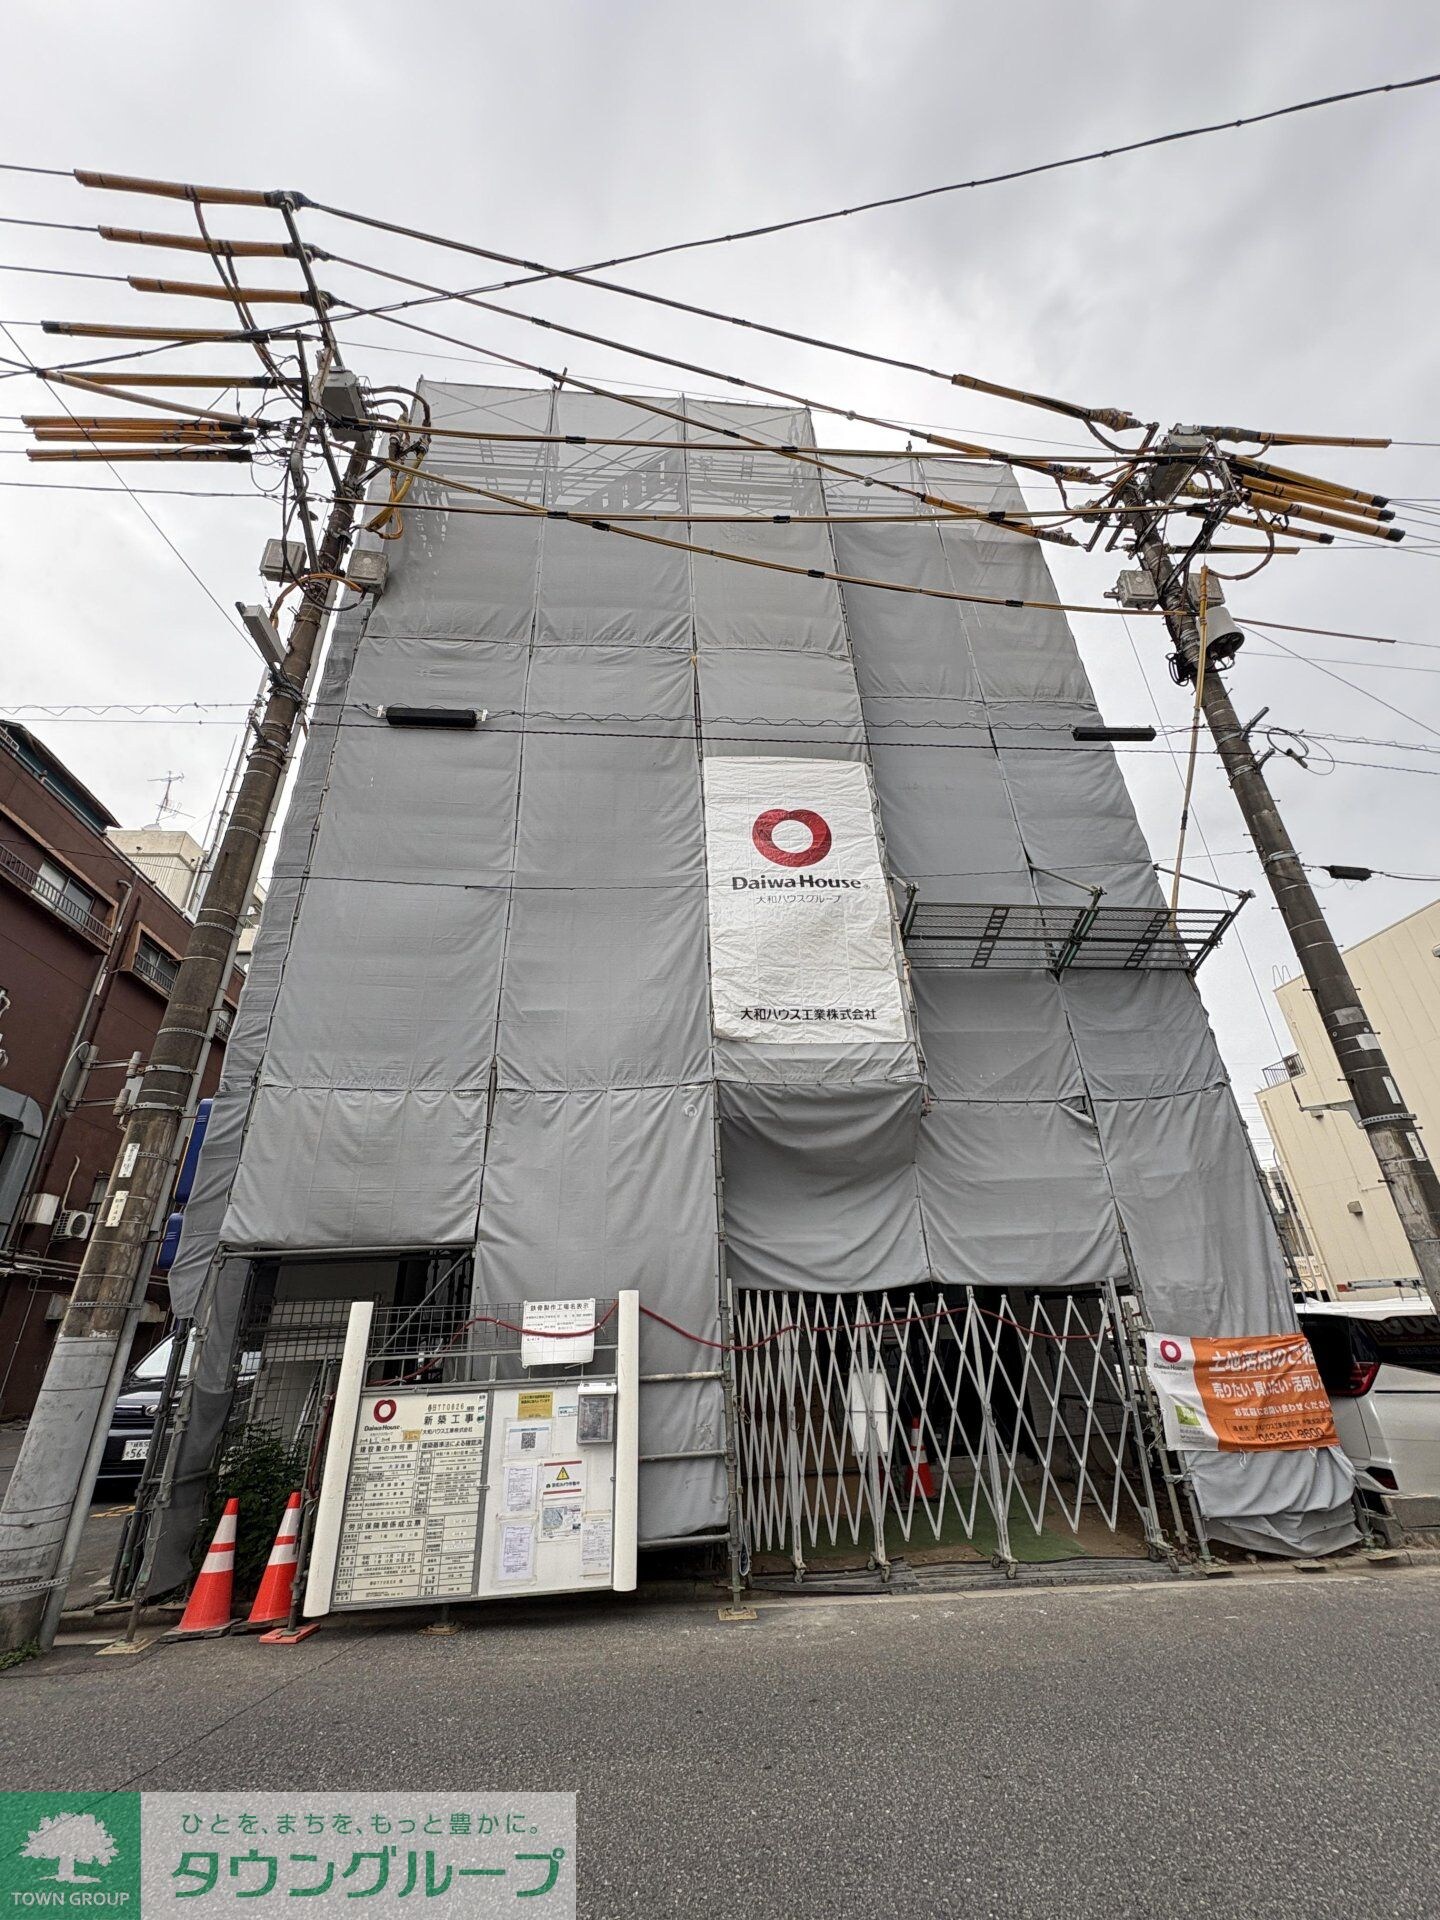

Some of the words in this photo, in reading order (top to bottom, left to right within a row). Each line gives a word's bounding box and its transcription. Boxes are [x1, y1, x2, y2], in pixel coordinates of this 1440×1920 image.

[732, 875, 796, 890] Daiwa
[799, 874, 862, 889] House
[756, 894, 841, 904] 大和ハウスグループ
[740, 1008, 877, 1021] 大和ハウス工業株式会社
[424, 1413, 474, 1426] 新築工事
[348, 1519, 421, 1530] 労災保険関係成立票
